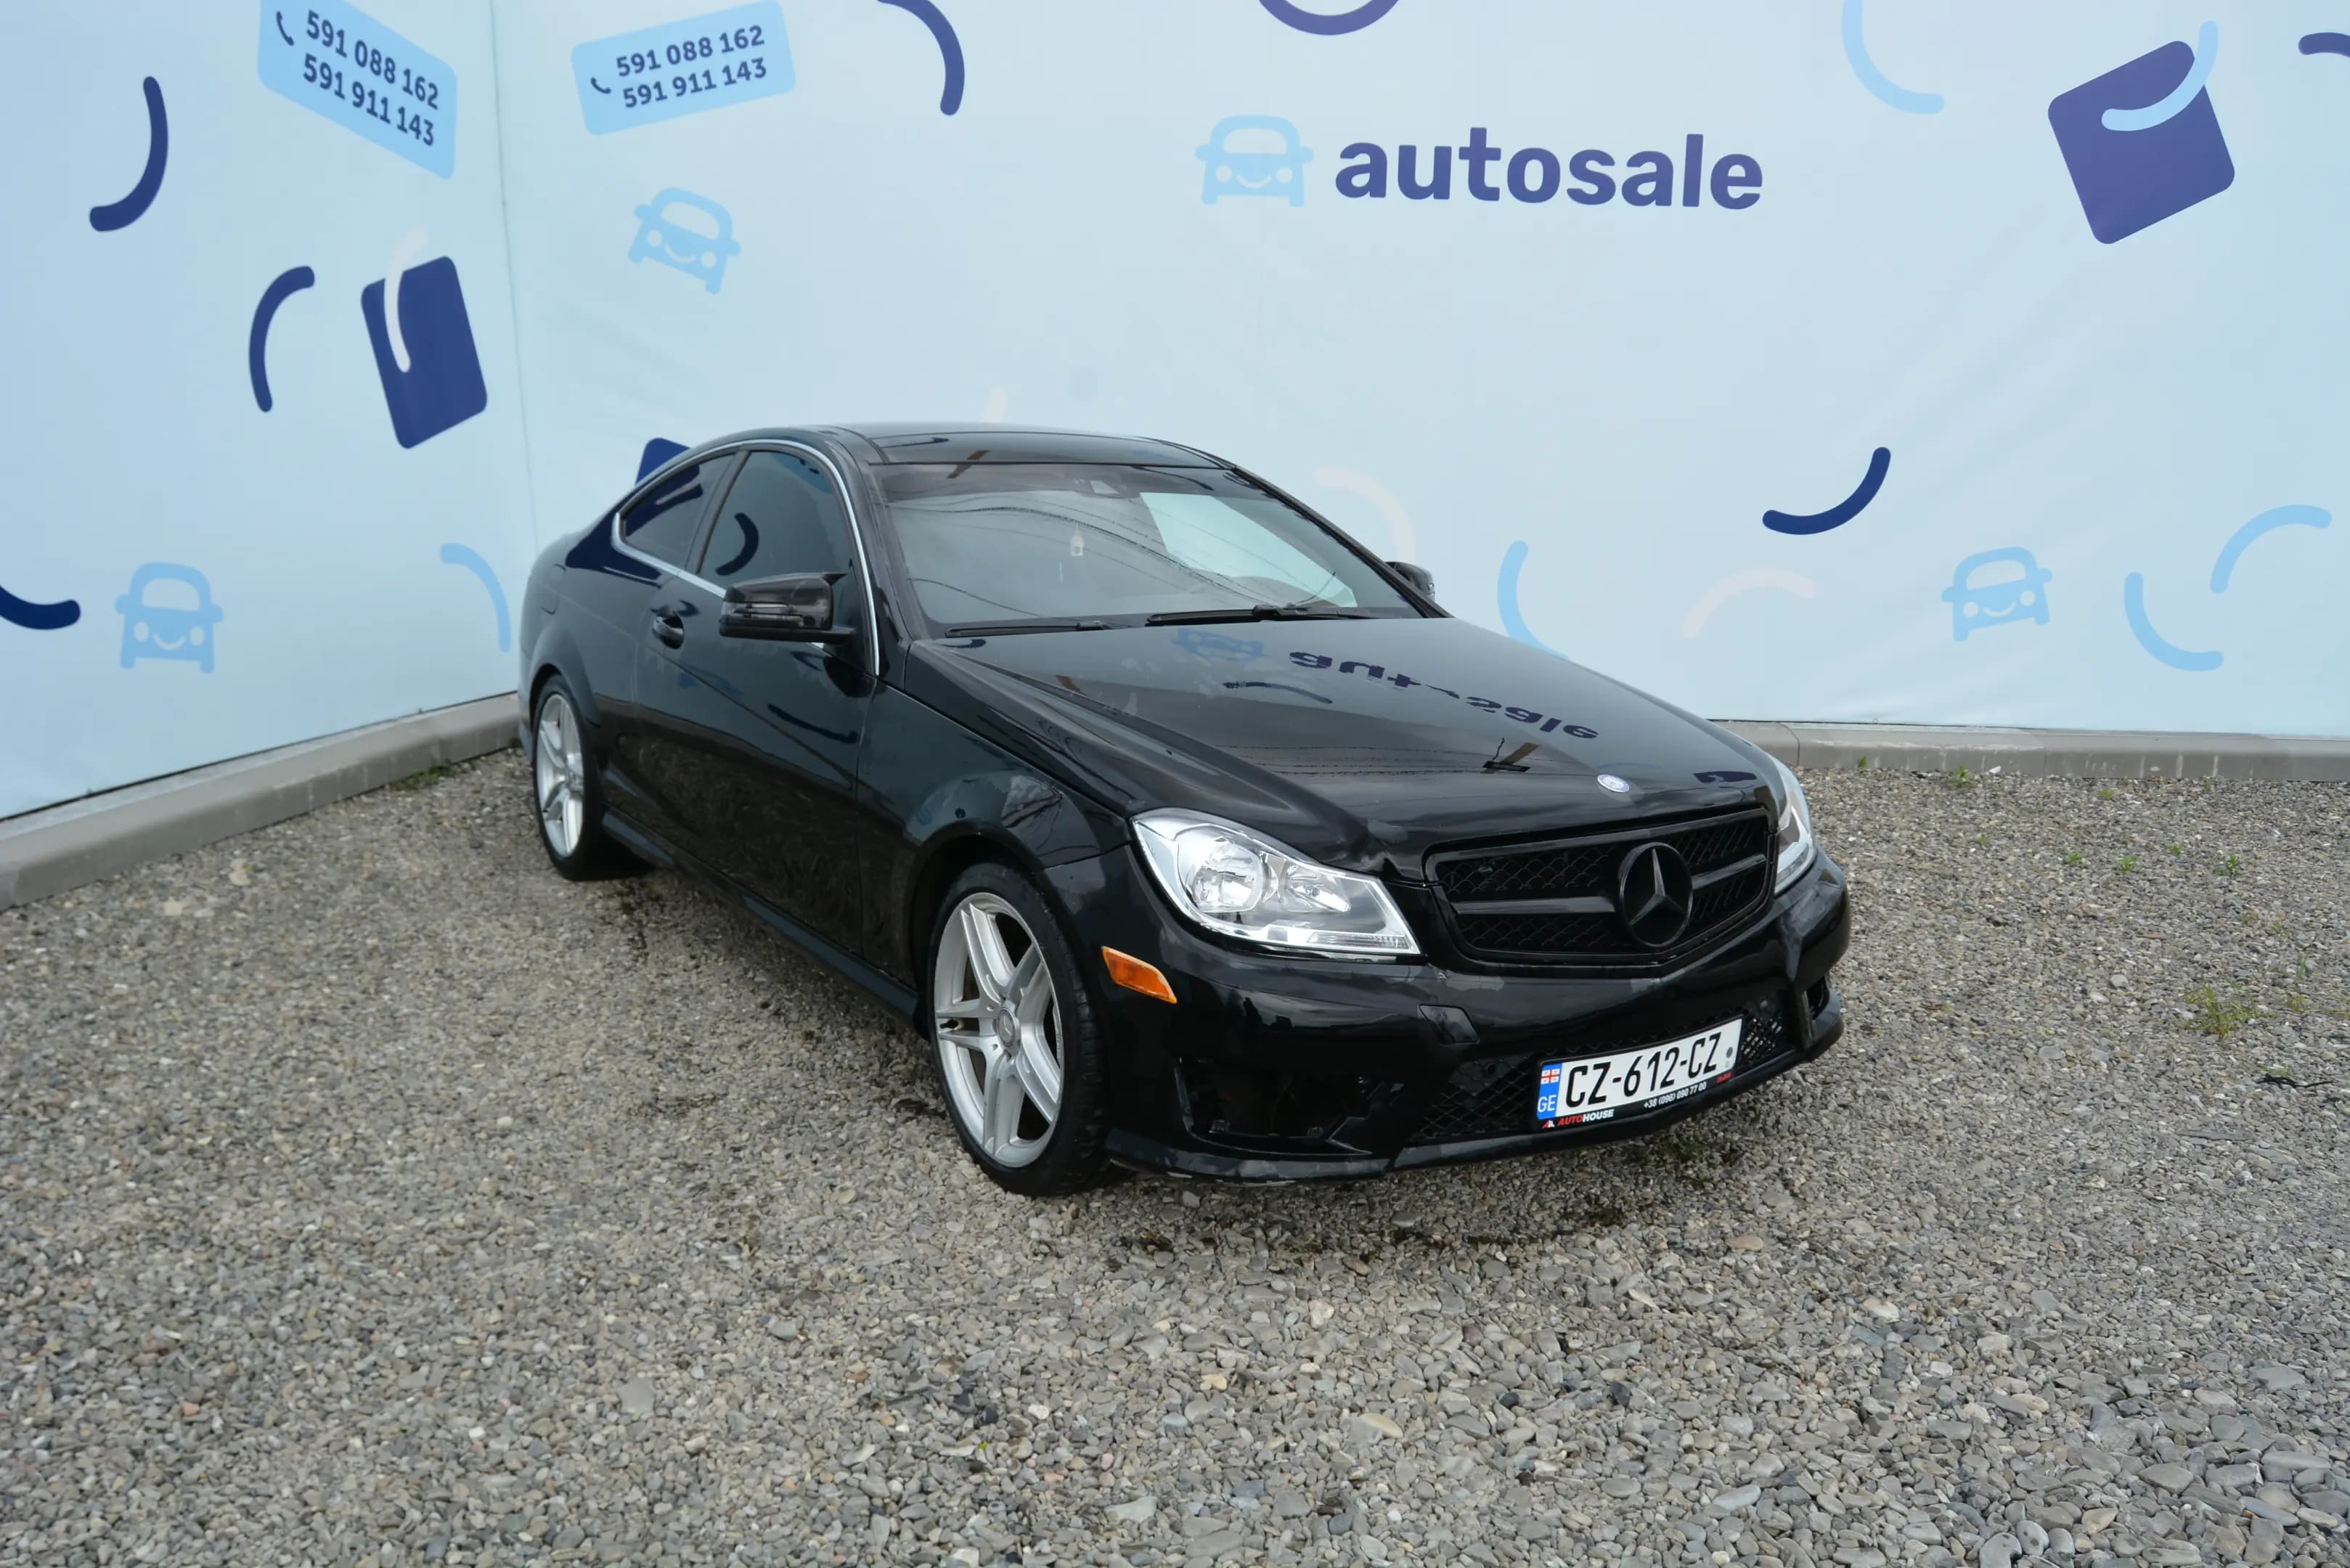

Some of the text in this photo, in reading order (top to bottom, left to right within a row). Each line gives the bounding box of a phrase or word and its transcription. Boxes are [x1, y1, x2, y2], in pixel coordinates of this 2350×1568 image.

[306, 9, 438, 110] 591 088 162
[616, 25, 765, 77] 591 088 162
[622, 57, 767, 108] 591 911 143
[303, 52, 434, 147] 591 911 143
[1334, 126, 1763, 211] autosale
[1565, 1032, 1721, 1108] CZ-612-CZ
[1537, 1094, 1557, 1113] GE
[1557, 1109, 1615, 1127] AUTOHOUSE
